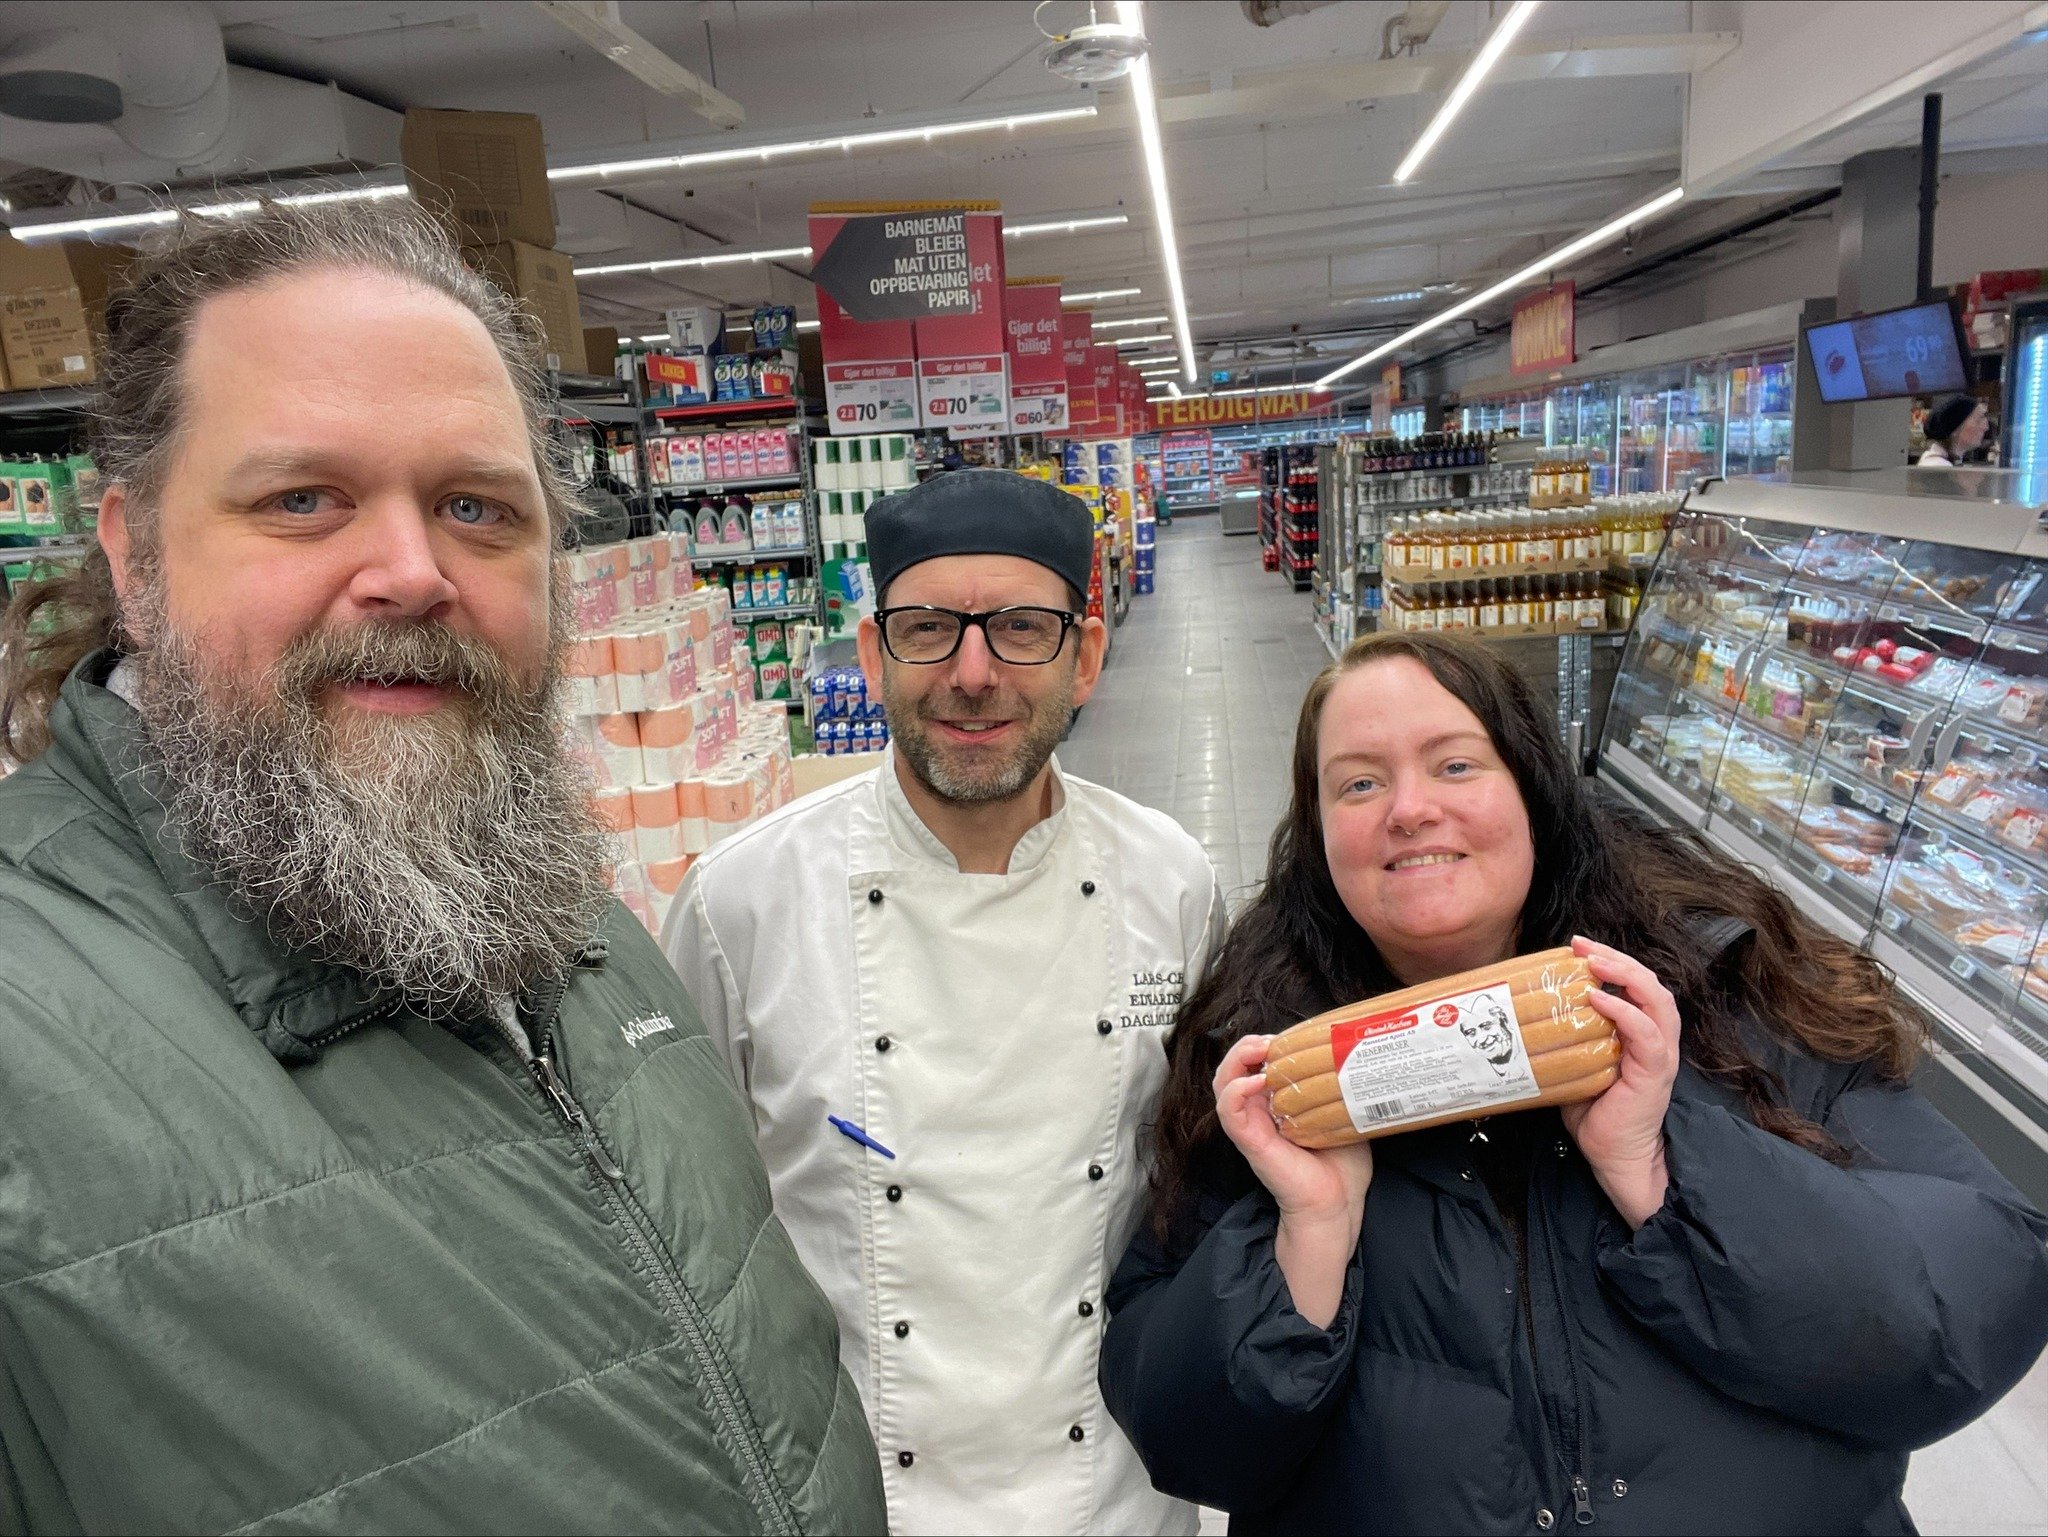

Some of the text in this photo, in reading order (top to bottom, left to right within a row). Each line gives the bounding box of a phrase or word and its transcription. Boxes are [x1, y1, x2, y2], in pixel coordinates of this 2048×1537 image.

[885, 215, 964, 238] BARNEMAT
[915, 235, 966, 254] BLEIER
[895, 253, 967, 274] MAT UTEN
[969, 262, 992, 282] et
[870, 271, 969, 295] OPPBEVARING
[928, 290, 970, 309] PAPIR
[1008, 318, 1058, 337] Gjør det
[1016, 337, 1051, 355] billig!
[857, 403, 877, 421] 70
[948, 397, 967, 415] 70
[1156, 391, 1310, 424] FERDIGMAT
[1028, 411, 1042, 423] 60
[757, 628, 781, 641] OMO
[763, 666, 787, 681] OMO
